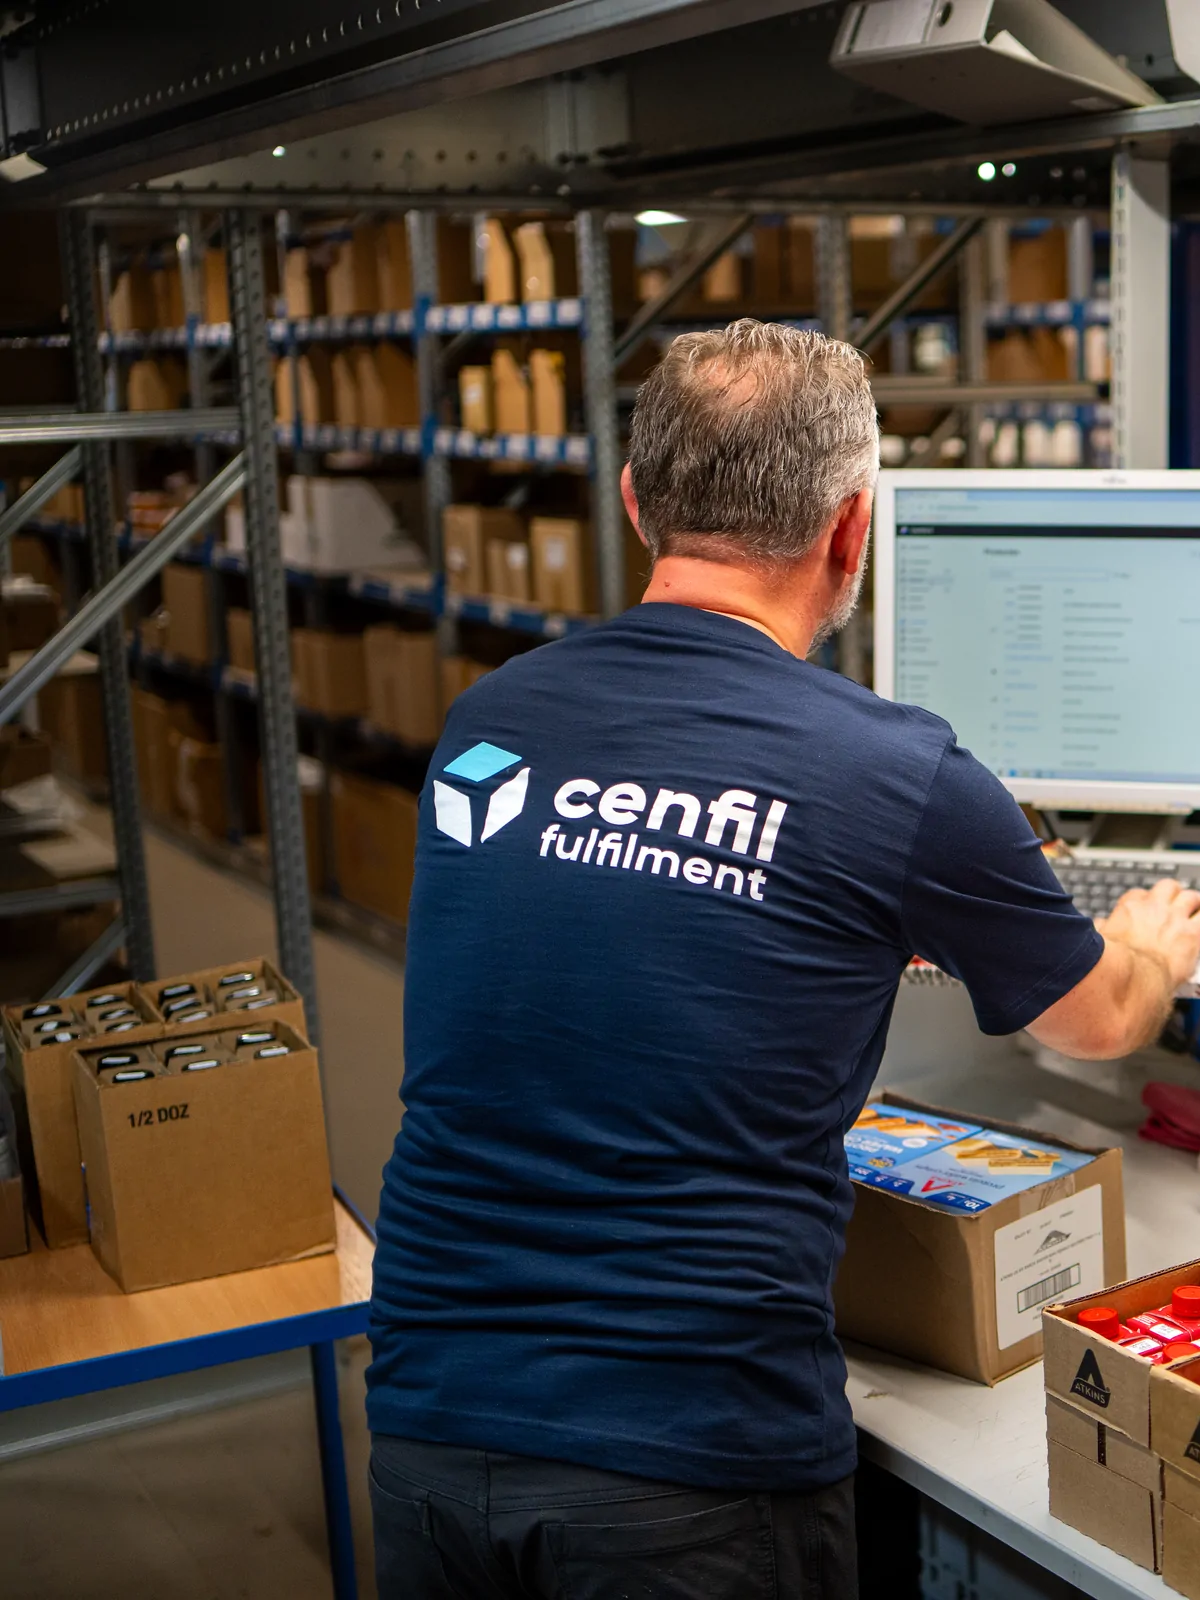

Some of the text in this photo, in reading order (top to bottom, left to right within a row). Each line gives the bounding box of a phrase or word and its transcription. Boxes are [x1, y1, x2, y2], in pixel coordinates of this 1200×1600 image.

[553, 778, 788, 863] cenfil
[538, 823, 768, 902] fulfilment
[127, 1103, 190, 1128] 1/2 DOZ
[1074, 1382, 1106, 1404] ATKINS
